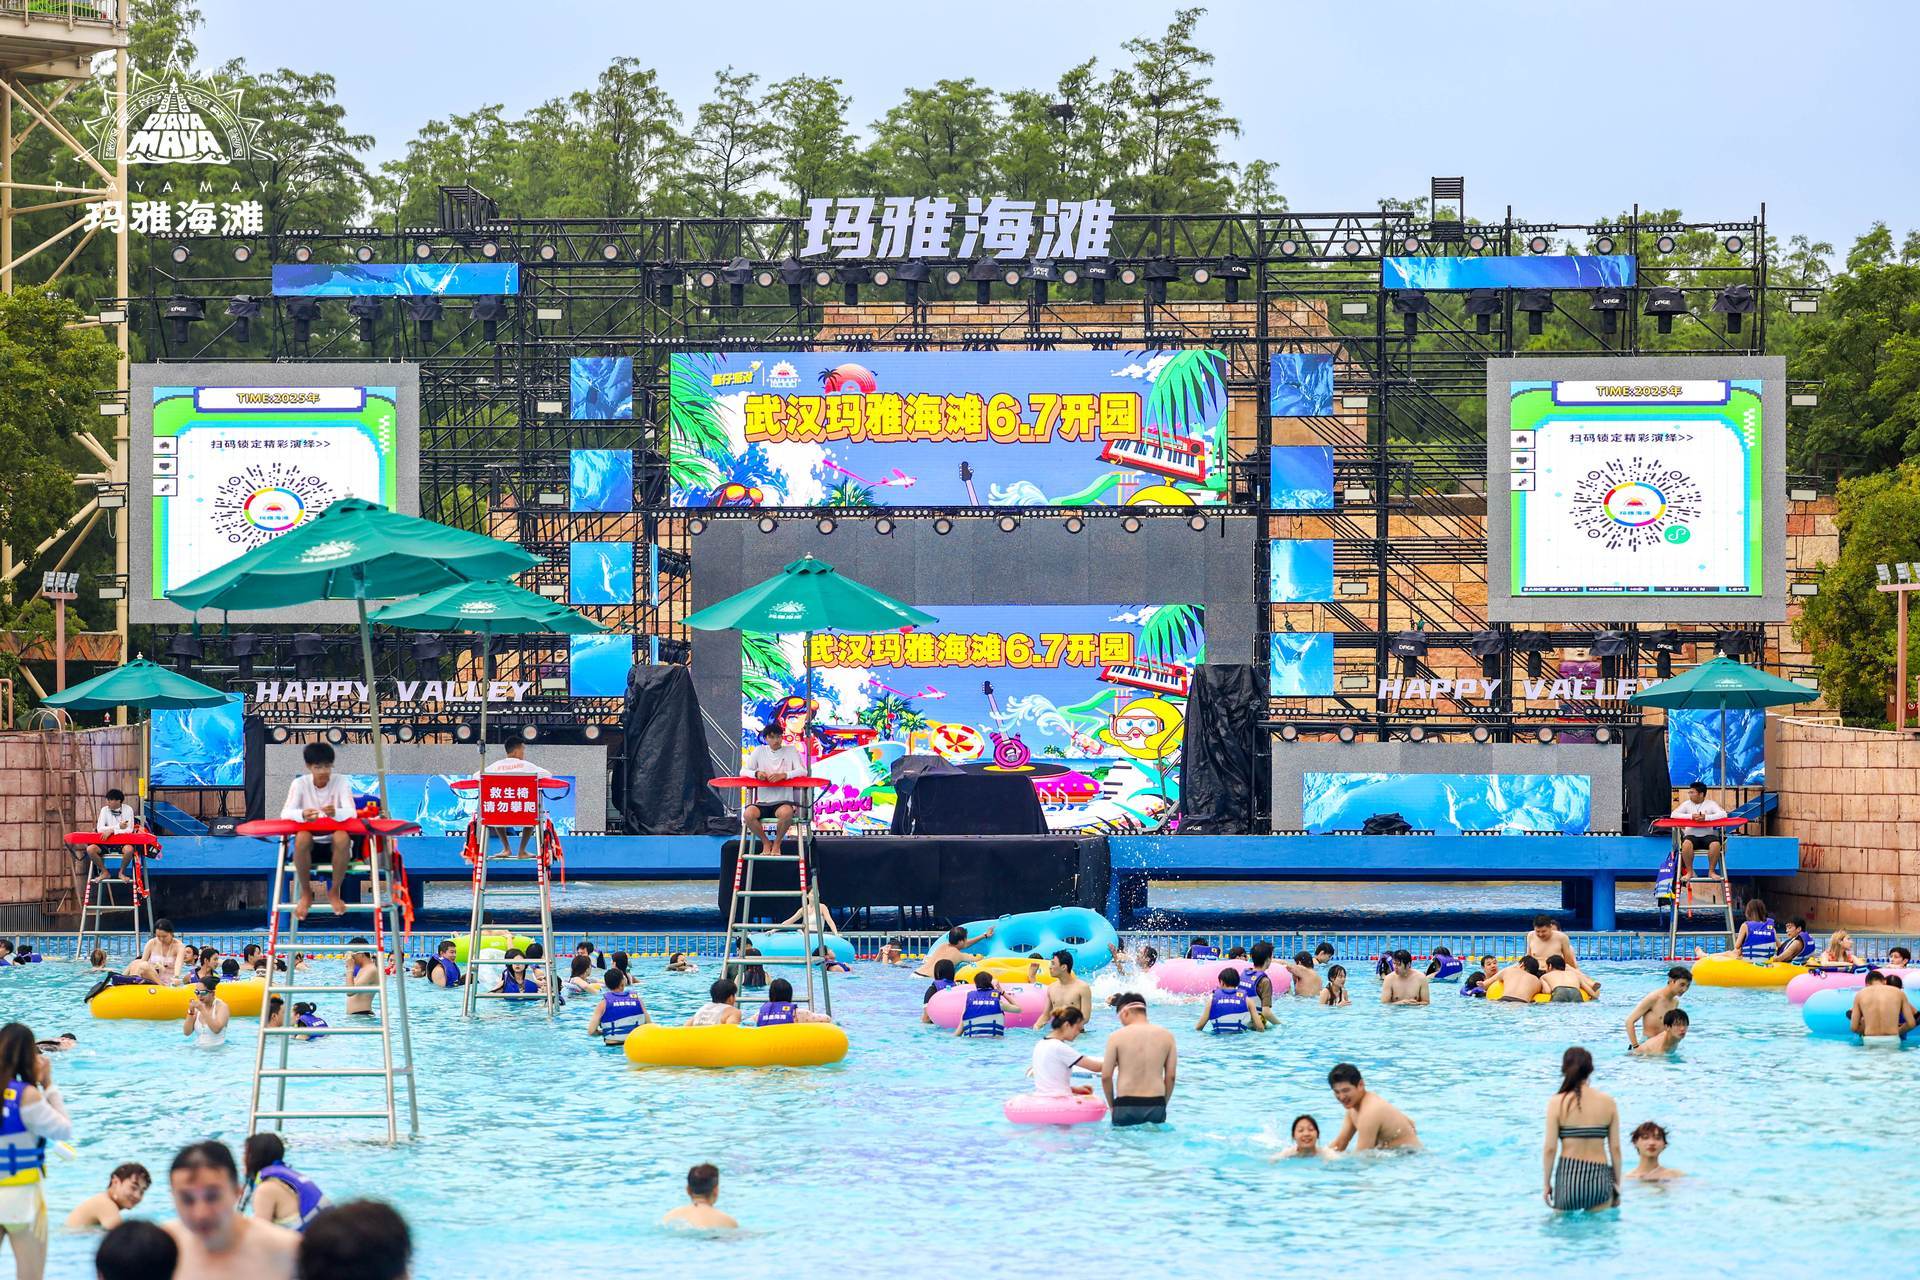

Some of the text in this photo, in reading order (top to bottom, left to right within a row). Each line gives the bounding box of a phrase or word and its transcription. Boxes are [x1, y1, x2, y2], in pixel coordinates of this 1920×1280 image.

[800, 196, 1116, 260] 玛雅海滩
[236, 392, 320, 405] TIME:2025年
[1596, 385, 1683, 397] TIME:2025年
[744, 392, 1142, 443] 武汉玛雅海滩6.7开园
[803, 632, 1135, 668] 武汉玛雅海滩6.7开园
[255, 680, 532, 702] HAPPY VALLEY
[1377, 678, 1501, 700] HAPPY
[490, 787, 529, 799] 救生椅
[483, 801, 536, 813] 请勿攀爬
